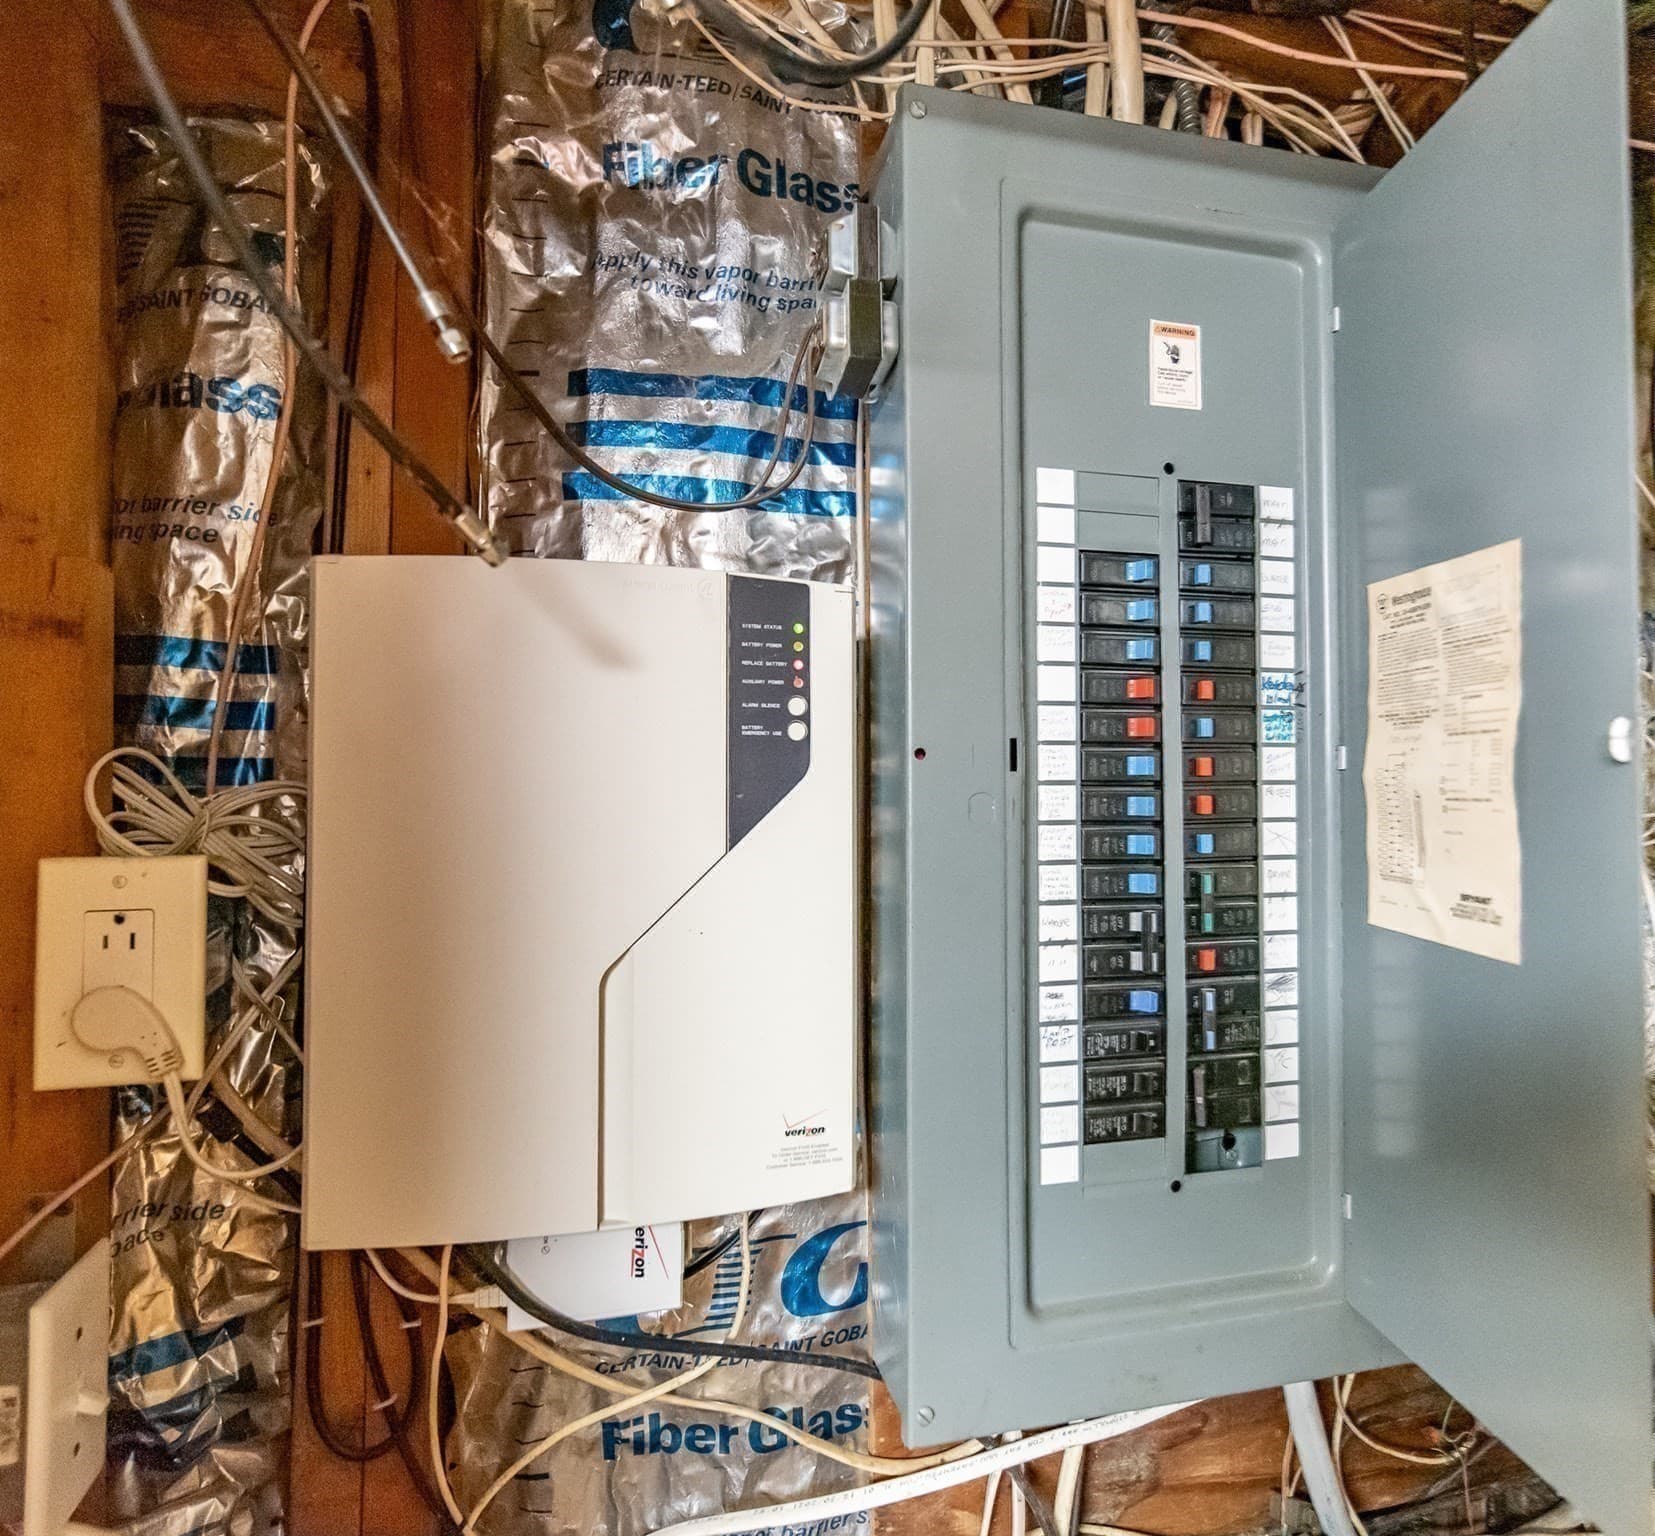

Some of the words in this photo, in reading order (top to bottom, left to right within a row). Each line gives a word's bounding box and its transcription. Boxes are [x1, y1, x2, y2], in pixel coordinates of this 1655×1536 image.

[602, 141, 726, 190] Fiber
[736, 148, 862, 213] Glass
[657, 256, 699, 281] this
[704, 265, 761, 284] vapor
[199, 284, 272, 313] GOBA
[714, 285, 771, 314] living
[1160, 326, 1196, 337] WARNING
[784, 1126, 826, 1137] verizon
[169, 1199, 226, 1222] side
[633, 1225, 645, 1278] erizon
[601, 1413, 738, 1461] Fiber
